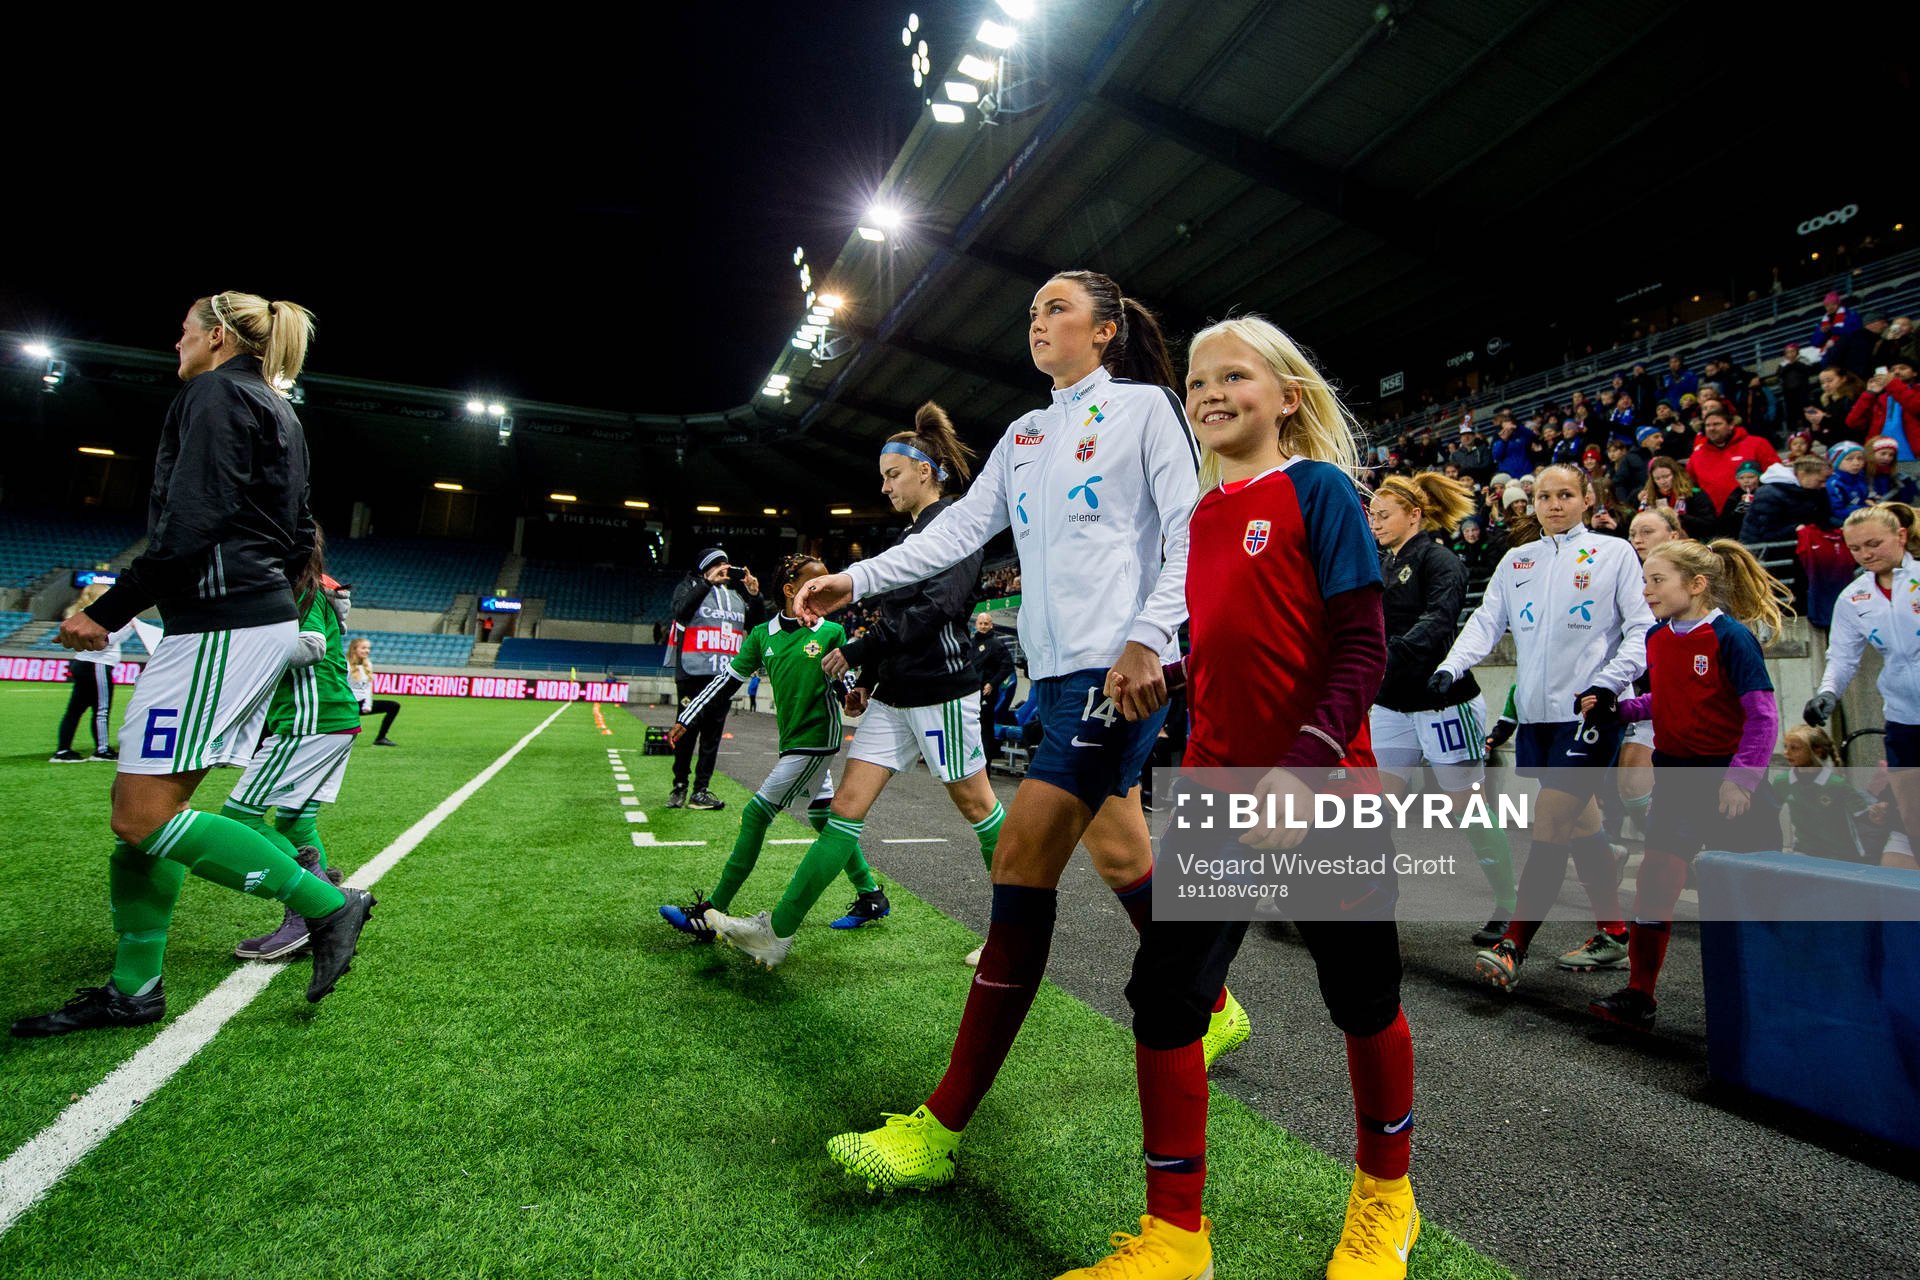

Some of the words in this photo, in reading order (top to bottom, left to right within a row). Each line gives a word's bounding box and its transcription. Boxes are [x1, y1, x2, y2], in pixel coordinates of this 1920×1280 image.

[1796, 203, 1860, 236] coop
[1018, 436, 1042, 445] TINE
[1068, 513, 1101, 522] telenor
[699, 606, 745, 623] Canon
[1567, 623, 1592, 631] telenor
[372, 673, 470, 697] VALIFISERING
[1081, 686, 1117, 728] 14
[141, 708, 178, 758] 6
[1431, 718, 1466, 753] 10
[1574, 720, 1599, 744] 16
[925, 729, 946, 766] 7
